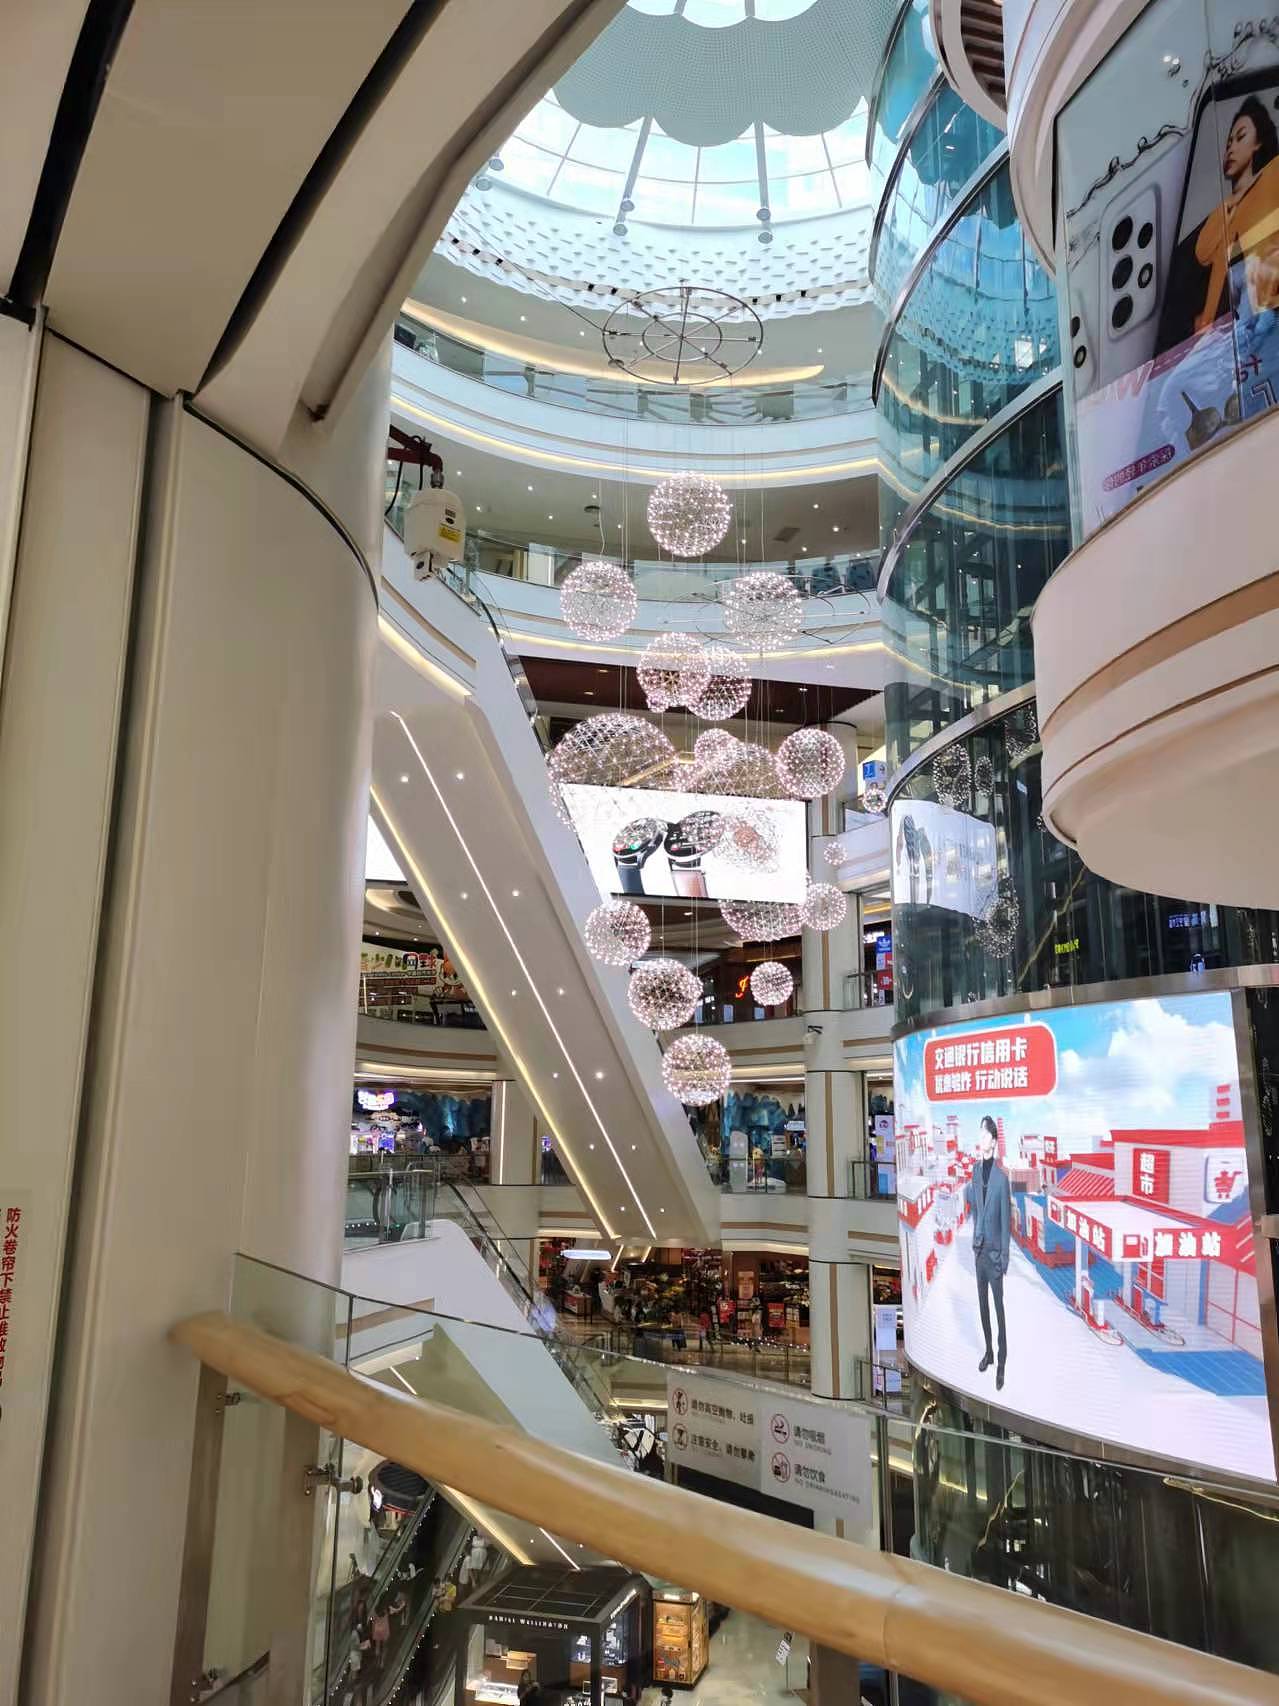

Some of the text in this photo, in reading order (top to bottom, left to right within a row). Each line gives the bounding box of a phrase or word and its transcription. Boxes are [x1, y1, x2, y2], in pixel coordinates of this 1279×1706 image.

[934, 1037, 1028, 1070] 交通银行信用卡
[975, 1066, 1028, 1091] 行动说话
[1140, 1151, 1156, 1195] 超市
[1066, 1210, 1107, 1253] 加油站
[1154, 1231, 1222, 1257] 加油站
[519, 1618, 569, 1630] WELLINGTON
